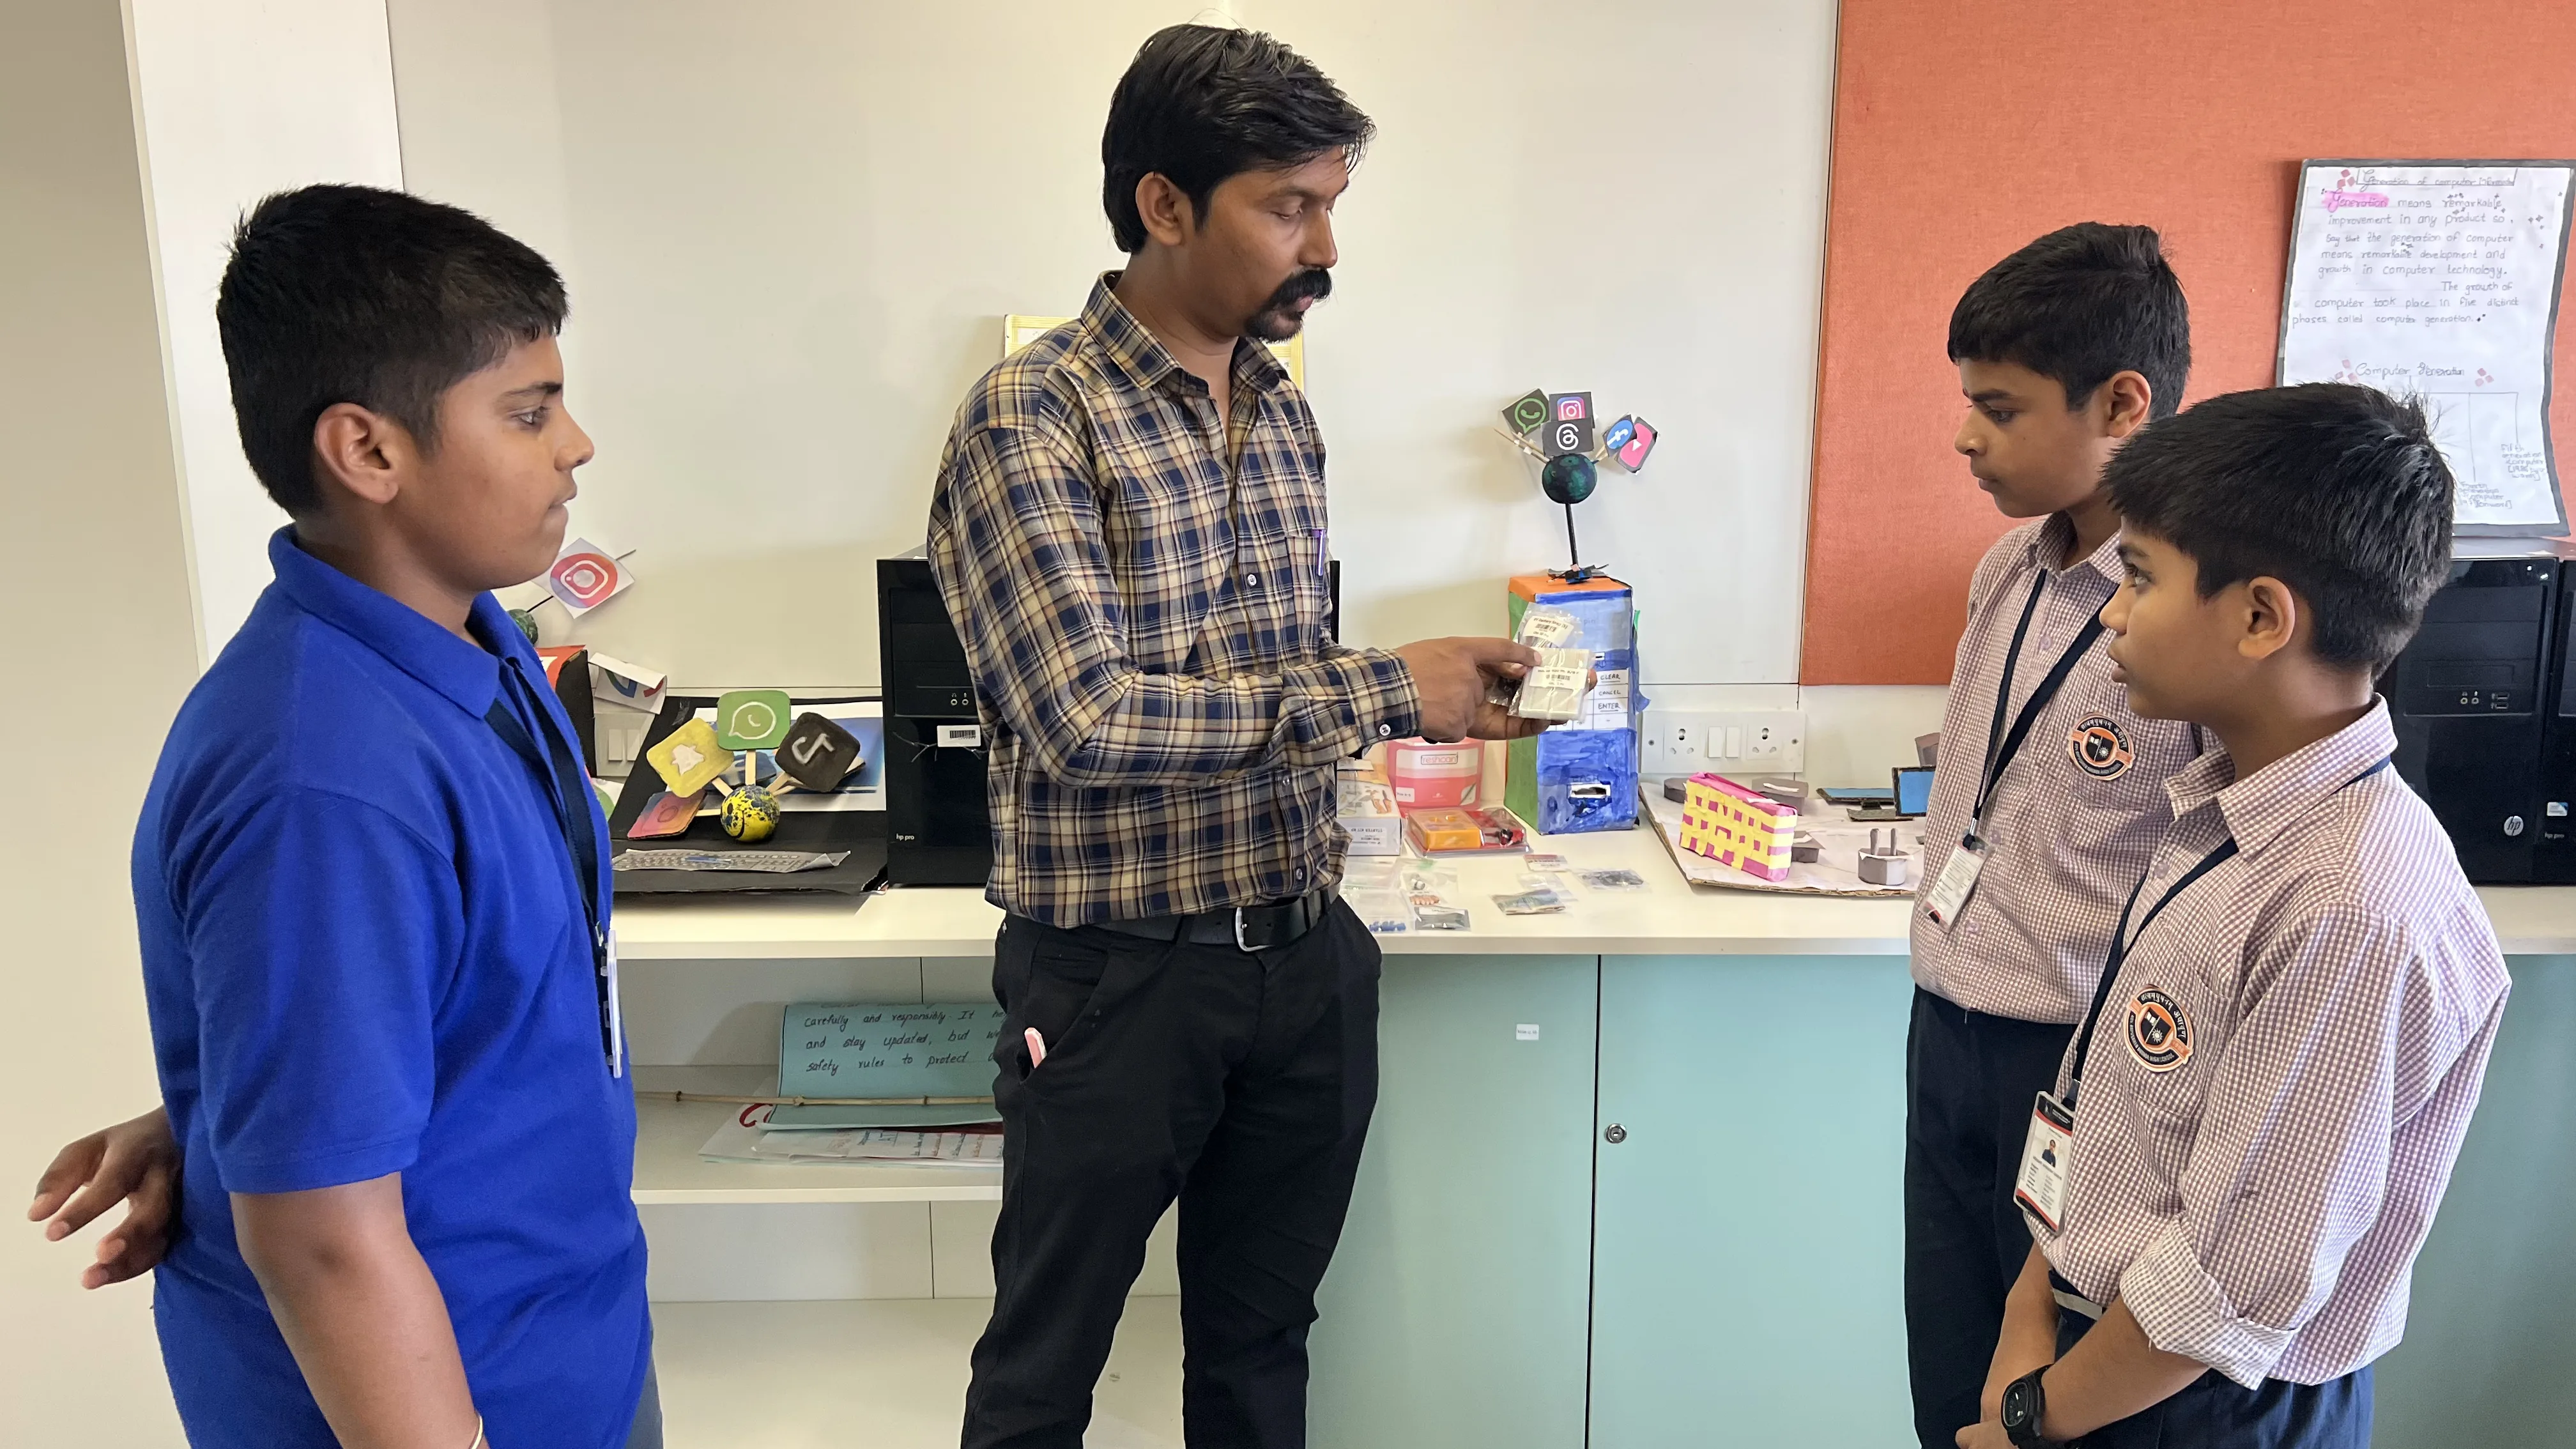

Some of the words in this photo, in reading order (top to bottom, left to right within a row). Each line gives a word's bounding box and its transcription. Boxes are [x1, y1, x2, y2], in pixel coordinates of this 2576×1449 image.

[2398, 199, 2432, 208] means
[2328, 215, 2392, 227] improvement
[2400, 214, 2411, 224] in
[2418, 215, 2437, 227] any
[2445, 213, 2486, 226] product
[2391, 233, 2441, 247] generation
[2446, 231, 2460, 242] of
[2466, 234, 2513, 247] computer
[2321, 250, 2353, 259] means
[2486, 249, 2506, 259] and
[2318, 264, 2352, 279] growth
[2363, 264, 2373, 275] in
[2382, 265, 2435, 280] computer
[2441, 281, 2458, 291] The
[2465, 282, 2499, 295] growth
[2502, 282, 2513, 291] of
[2314, 297, 2364, 310] computer
[2373, 296, 2396, 307] took
[2405, 298, 2430, 309] place
[2460, 296, 2477, 307] five
[2292, 313, 2327, 329] phases
[2337, 314, 2363, 323] called
[2355, 362, 2411, 380] Computer
[804, 1014, 848, 1032] carefully
[863, 1013, 882, 1023] and
[957, 1010, 975, 1020] It
[806, 1036, 827, 1049] and
[843, 1036, 866, 1051] stay
[884, 1031, 932, 1050] updated,
[947, 1029, 970, 1041] but
[806, 1059, 839, 1076] safety
[858, 1056, 885, 1068] rules
[902, 1053, 914, 1064] to
[925, 1051, 969, 1068] protect
